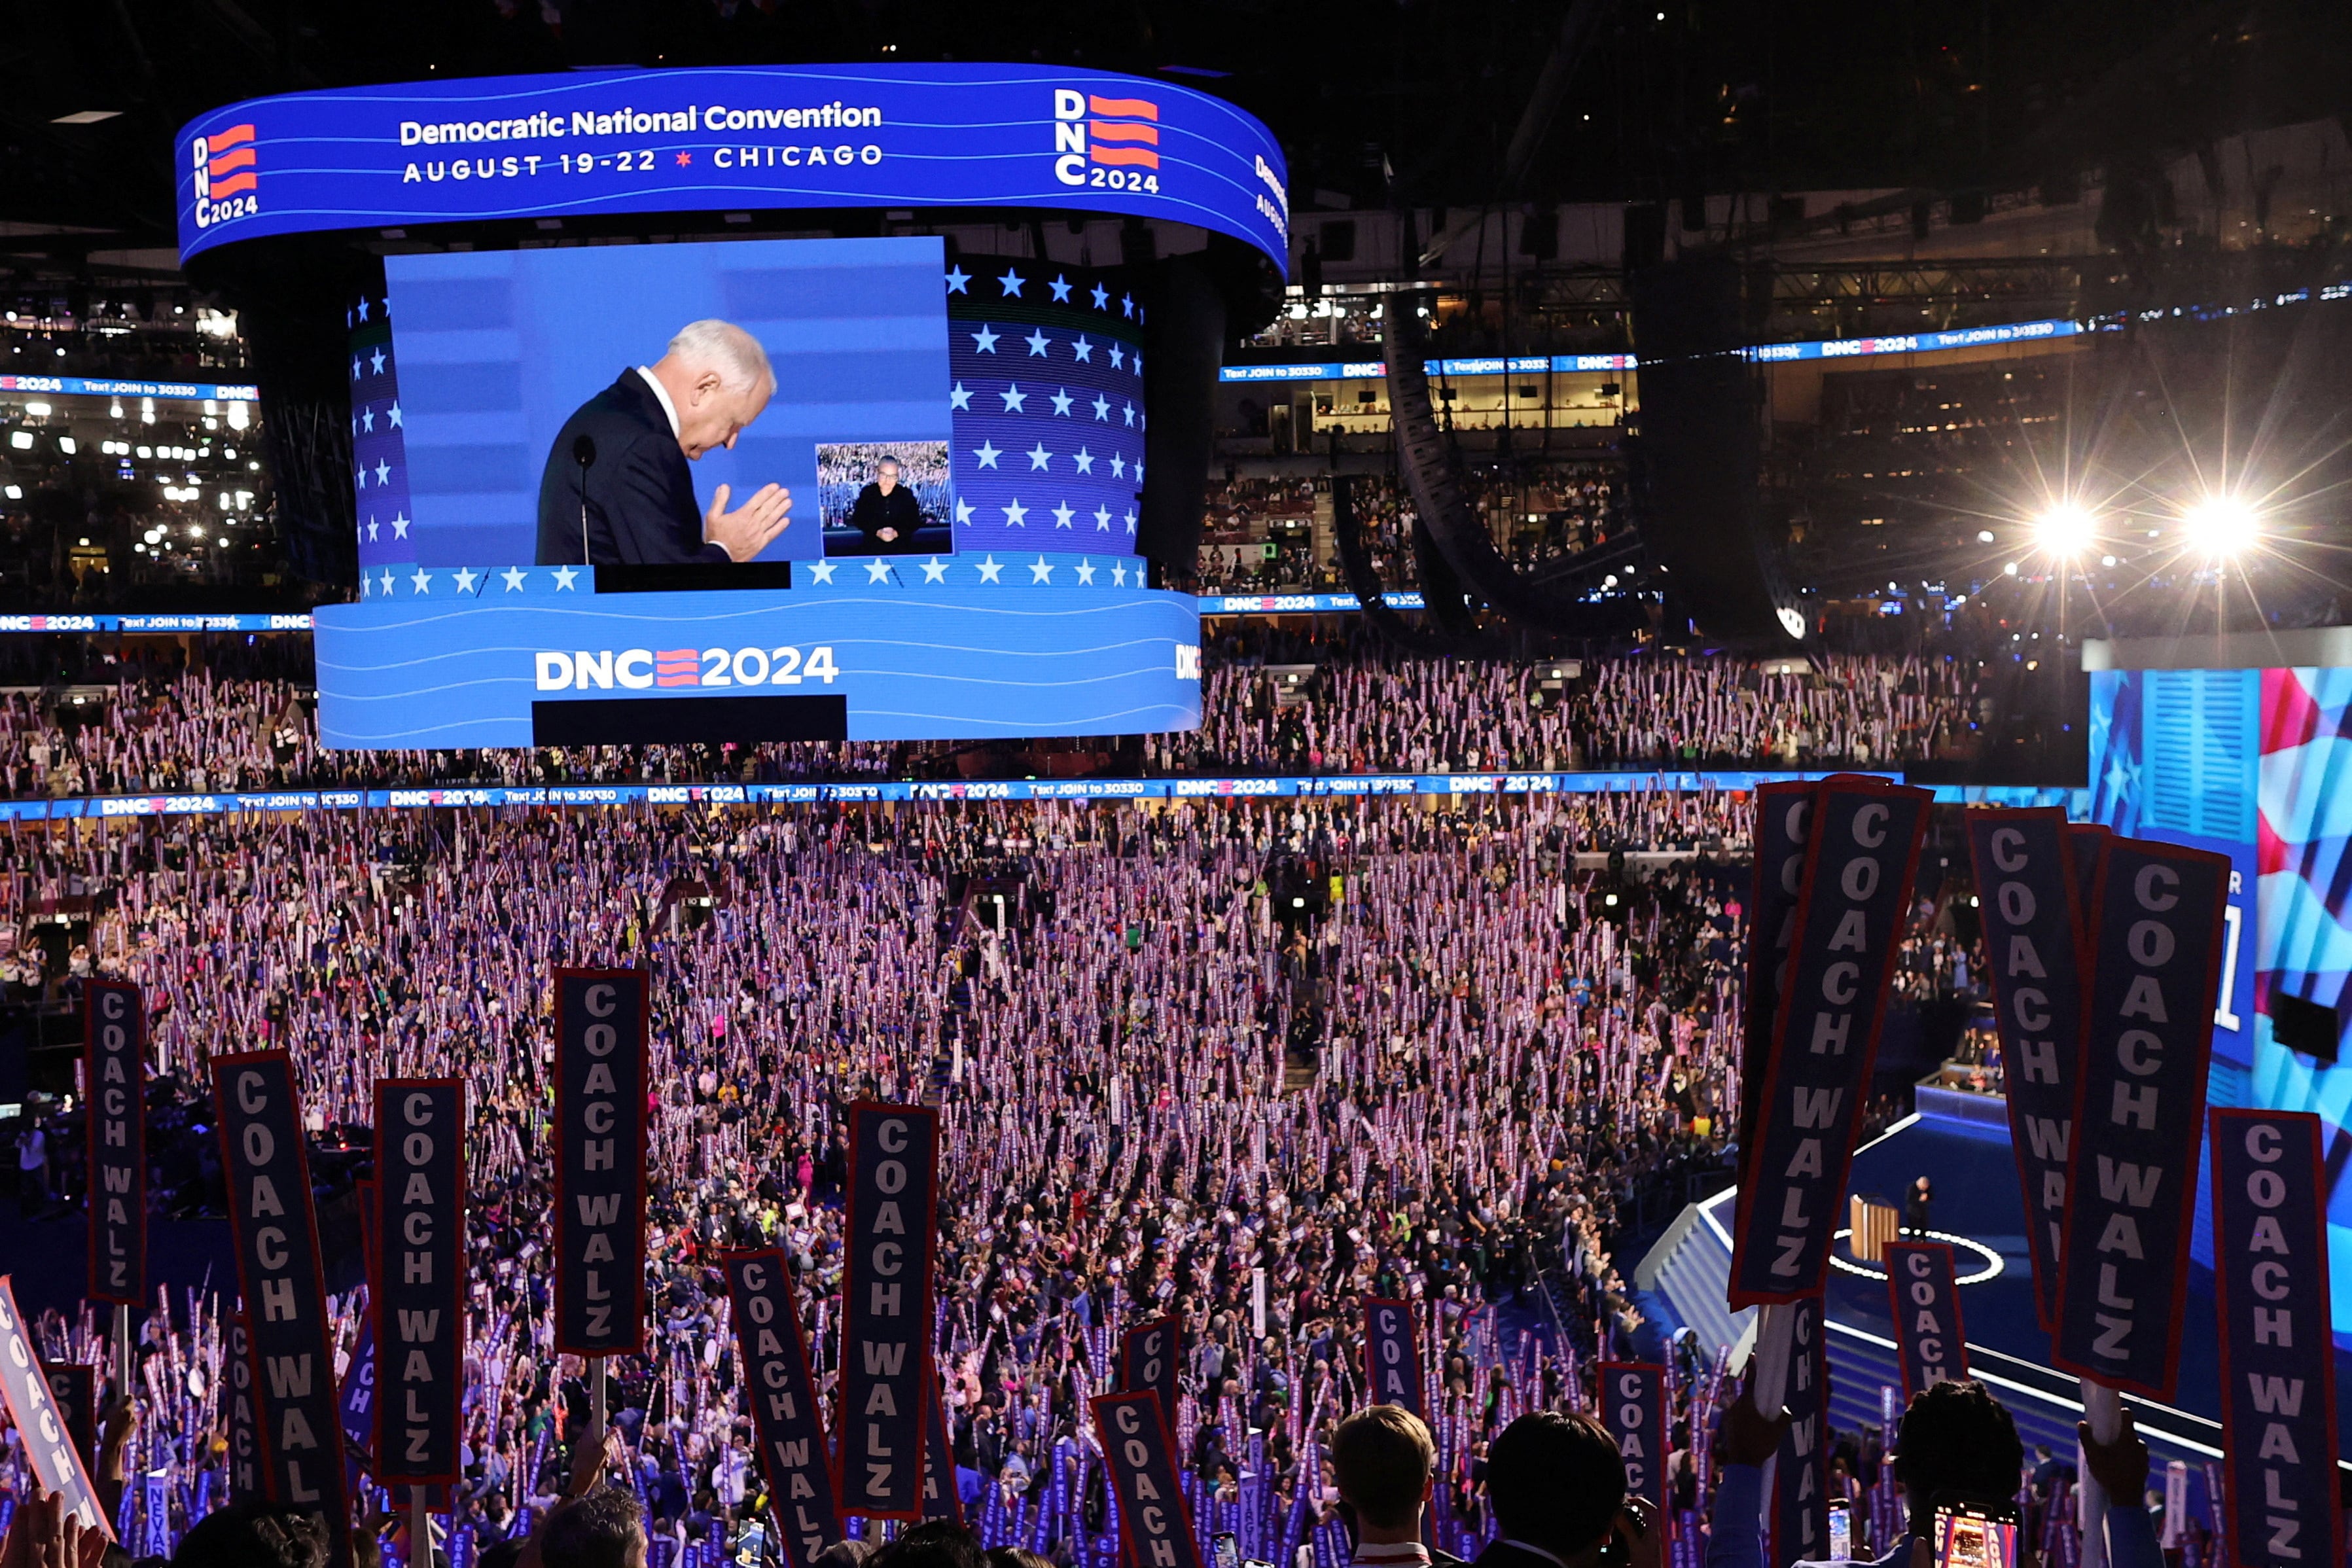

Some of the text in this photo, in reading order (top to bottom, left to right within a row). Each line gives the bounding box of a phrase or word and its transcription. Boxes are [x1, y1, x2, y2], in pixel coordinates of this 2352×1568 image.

[400, 101, 882, 146] Democratic National Convention
[403, 145, 882, 183] AUGUST 19-22 CHICAGO
[1091, 168, 1159, 194] 2024
[211, 196, 258, 221] 2024
[16, 377, 62, 391] 2024
[1224, 365, 1322, 380] Text JOIN to 30330
[83, 382, 196, 396] Text JOIN to 30330
[1224, 596, 1316, 611] DNC 2024
[1329, 597, 1355, 607] Text
[46, 616, 95, 630] 2024
[147, 618, 179, 629] JOIN
[535, 647, 839, 691] DNC 2024
[390, 791, 429, 806] DNC
[647, 787, 688, 803] DNC
[1029, 785, 1059, 796] Text
[1060, 783, 1088, 795] JOIN
[1177, 779, 1278, 794] DNC 2024
[1449, 776, 1493, 791] DNC
[101, 796, 215, 815] DNC 2024
[268, 796, 300, 807] JOIN
[1809, 802, 1890, 1056] COACH
[1991, 828, 2060, 1085] COACH
[2093, 864, 2181, 1361] COACH WALZ
[102, 992, 132, 1287] COACH WALZ
[577, 984, 621, 1338] COACH WALZ
[1770, 1086, 1841, 1277] WALZ
[398, 1092, 439, 1463] COACH WALZ
[237, 1071, 324, 1517] COACH WAL
[863, 1118, 908, 1497] COACH WALZ
[2245, 1124, 2304, 1559] COACH WALZ
[743, 1263, 825, 1563] COACH WALZ
[1116, 1406, 1177, 1567] COACH
[1792, 1411, 1816, 1561] WAL
